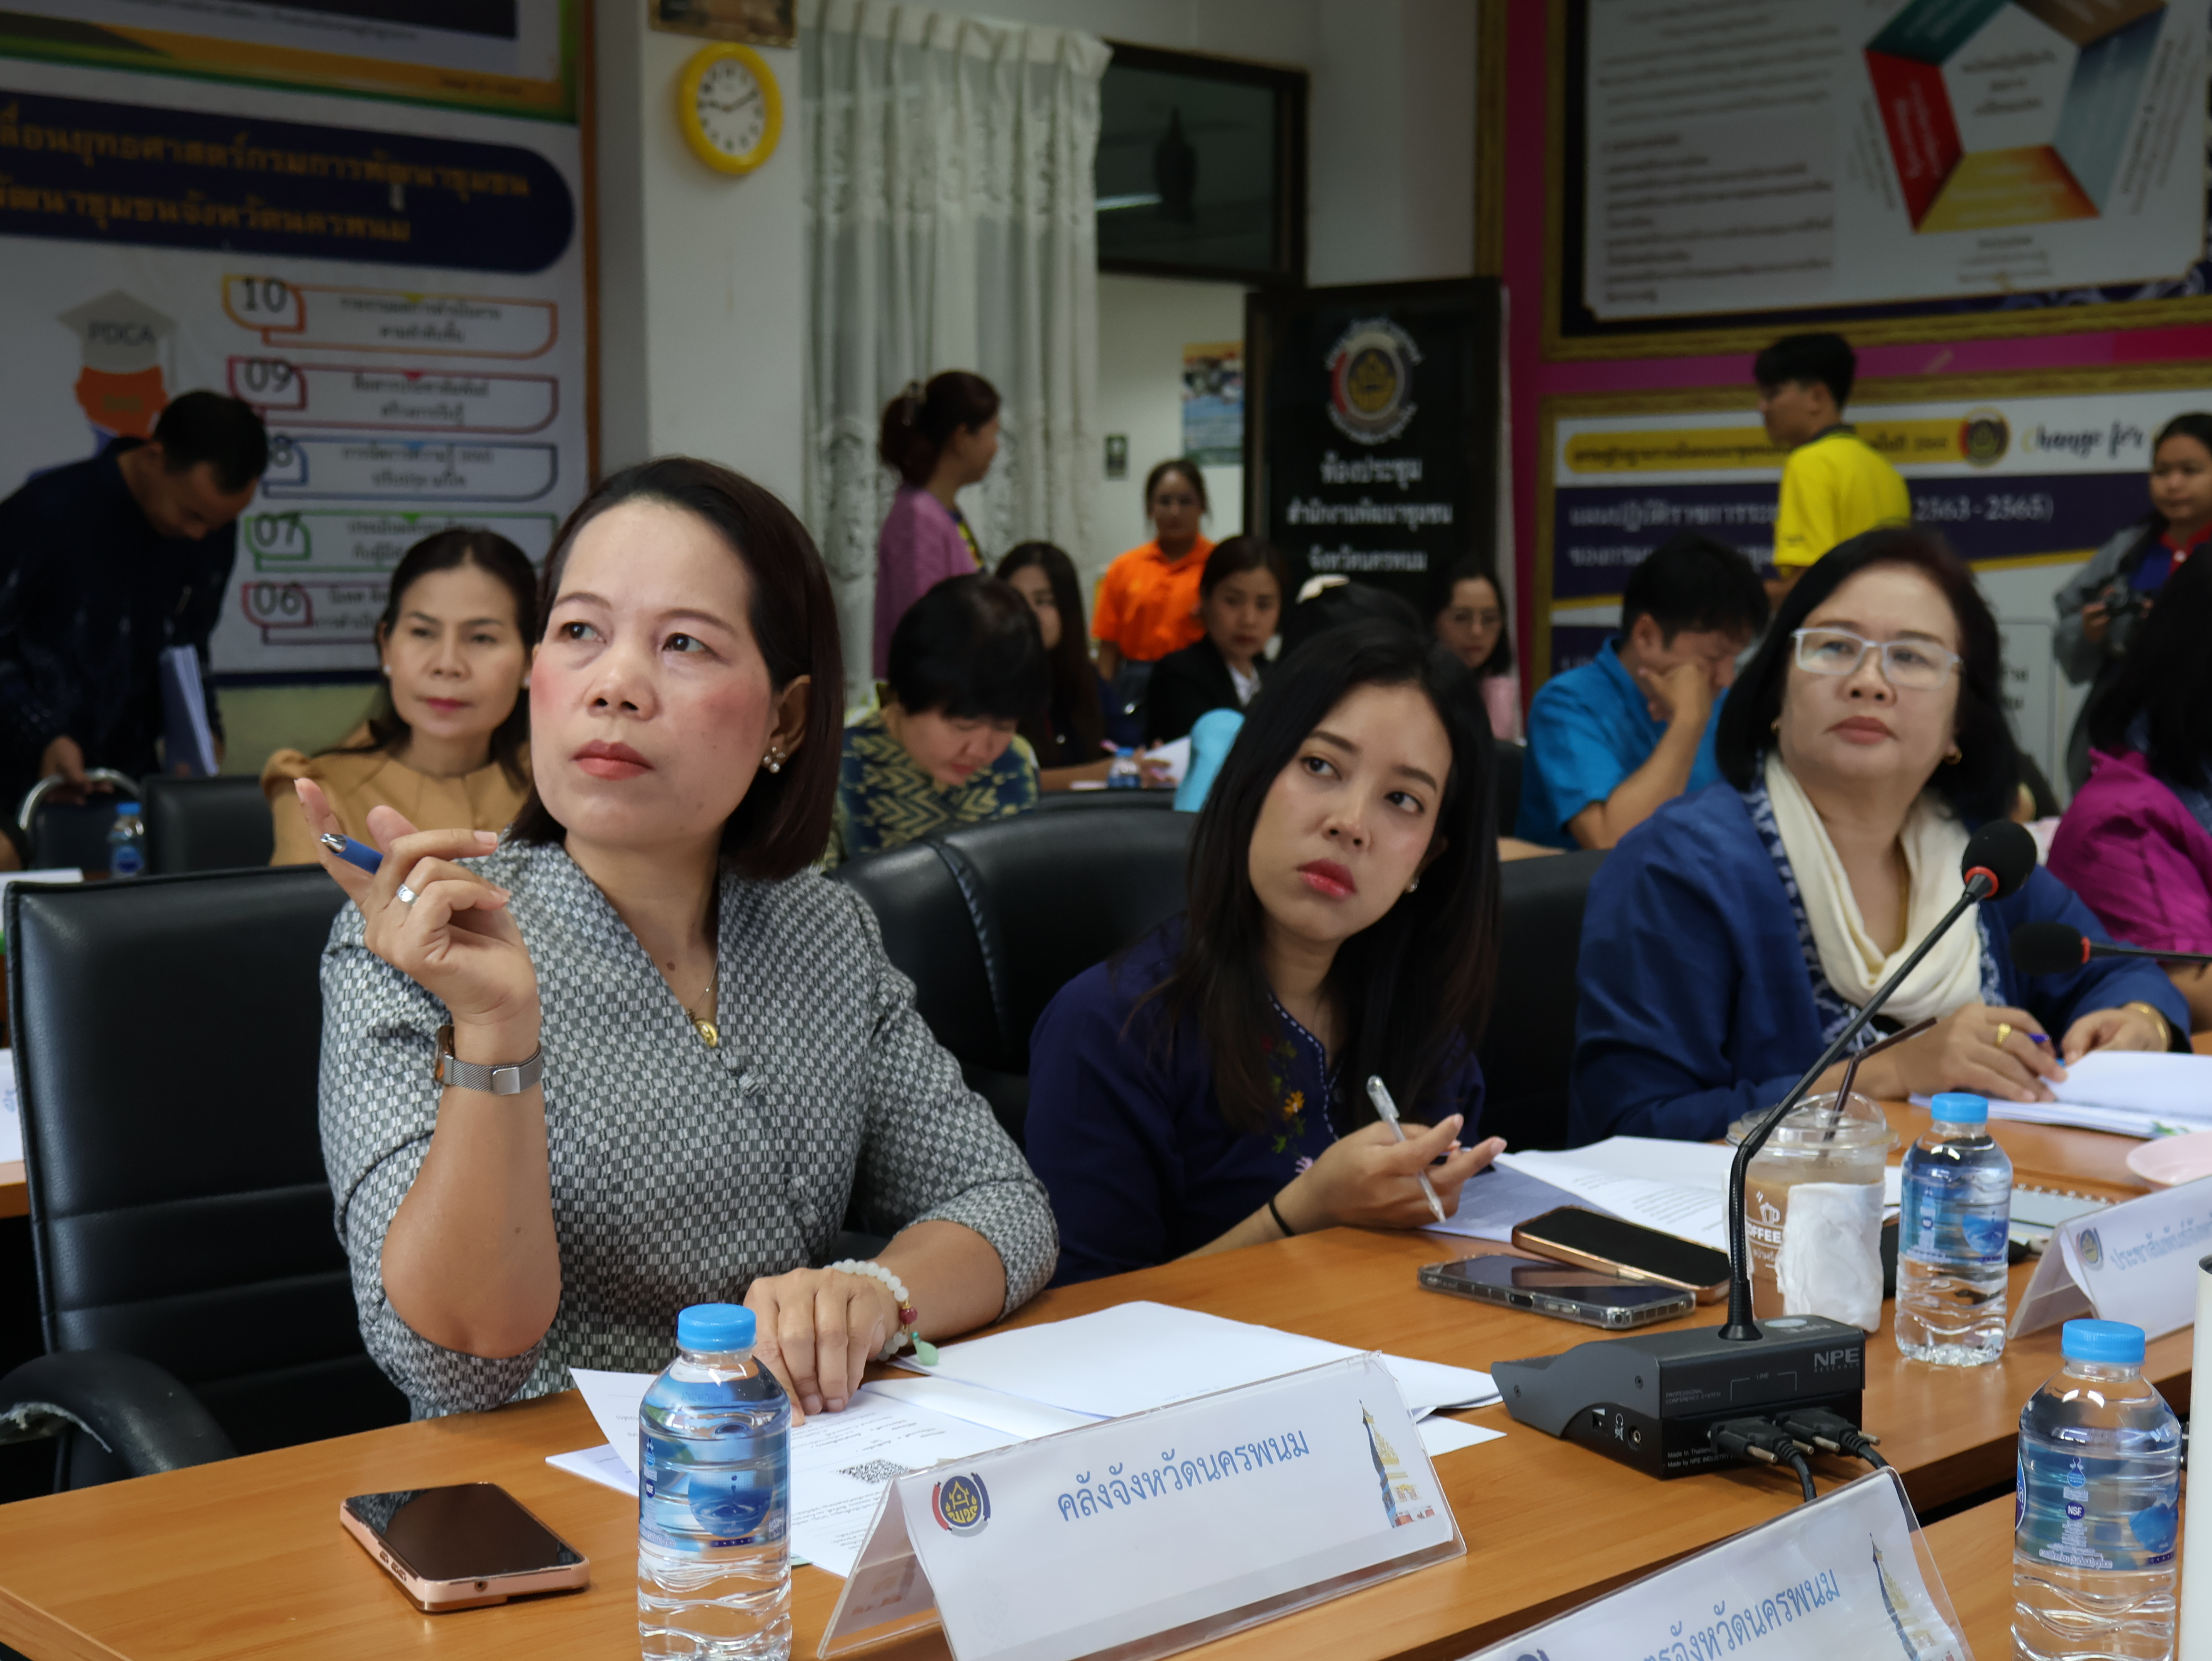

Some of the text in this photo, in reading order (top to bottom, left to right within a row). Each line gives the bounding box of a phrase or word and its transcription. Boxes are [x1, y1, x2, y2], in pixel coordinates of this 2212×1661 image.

[244, 276, 287, 312] 10
[88, 320, 156, 346] PDCA
[244, 358, 294, 392] 09
[267, 435, 293, 468] 8
[1321, 450, 1423, 491] ห้องประชุม
[1914, 495, 1970, 522] 2563
[254, 512, 301, 546] 07
[254, 582, 301, 615] 06
[1745, 1222, 1781, 1244] OFFEE
[1813, 1362, 1860, 1373] RESEARCH
[1814, 1347, 1860, 1368] NPE
[1666, 1388, 1703, 1398] PROFESSIONAL
[1666, 1391, 1721, 1405] CONFERENCE SYSTEM
[1057, 1430, 1310, 1522] คลังจังหวัดนครพนม
[2068, 1504, 2082, 1517] NSF
